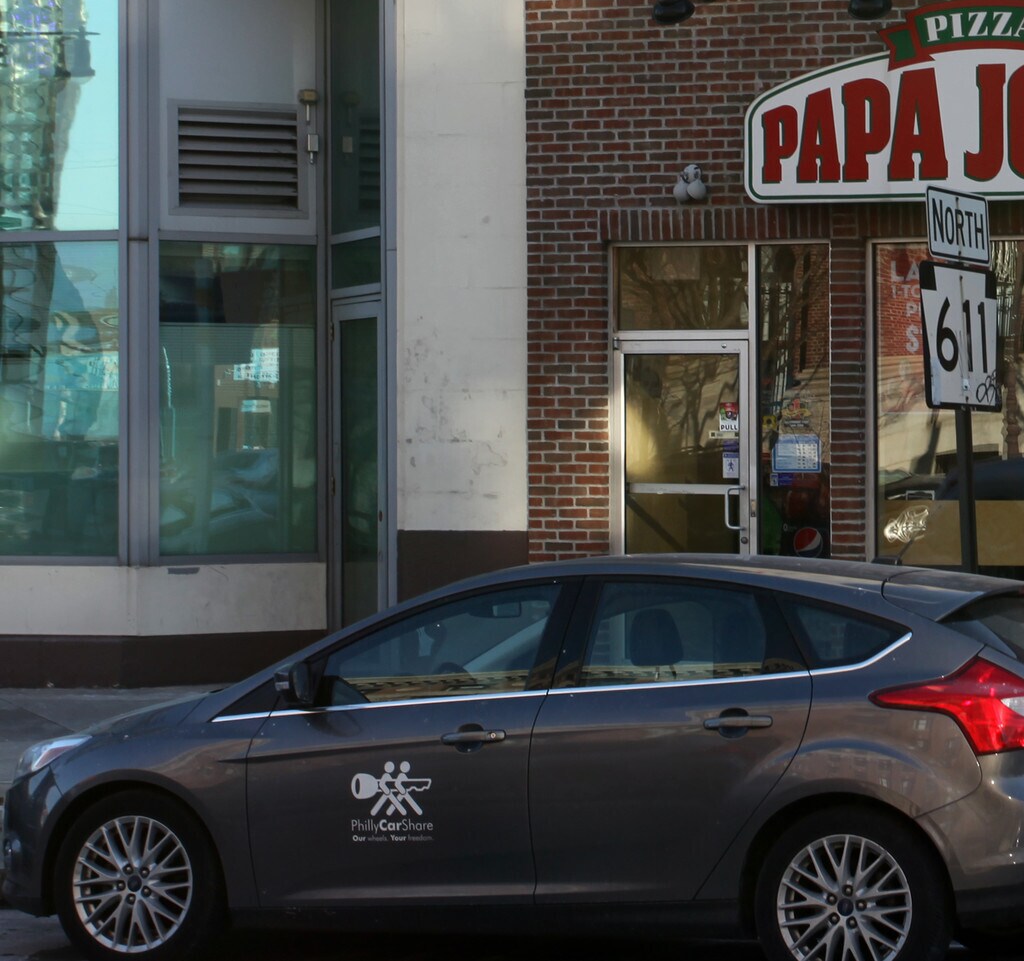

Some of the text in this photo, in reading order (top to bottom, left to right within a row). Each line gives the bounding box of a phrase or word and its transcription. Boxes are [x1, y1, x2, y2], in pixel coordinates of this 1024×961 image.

[761, 67, 948, 184] PAPA
[932, 197, 985, 250] NORTH
[936, 296, 988, 374] 611
[351, 818, 434, 834] PhillyCarShare
[352, 834, 366, 842] Our
[390, 834, 407, 842] Your
